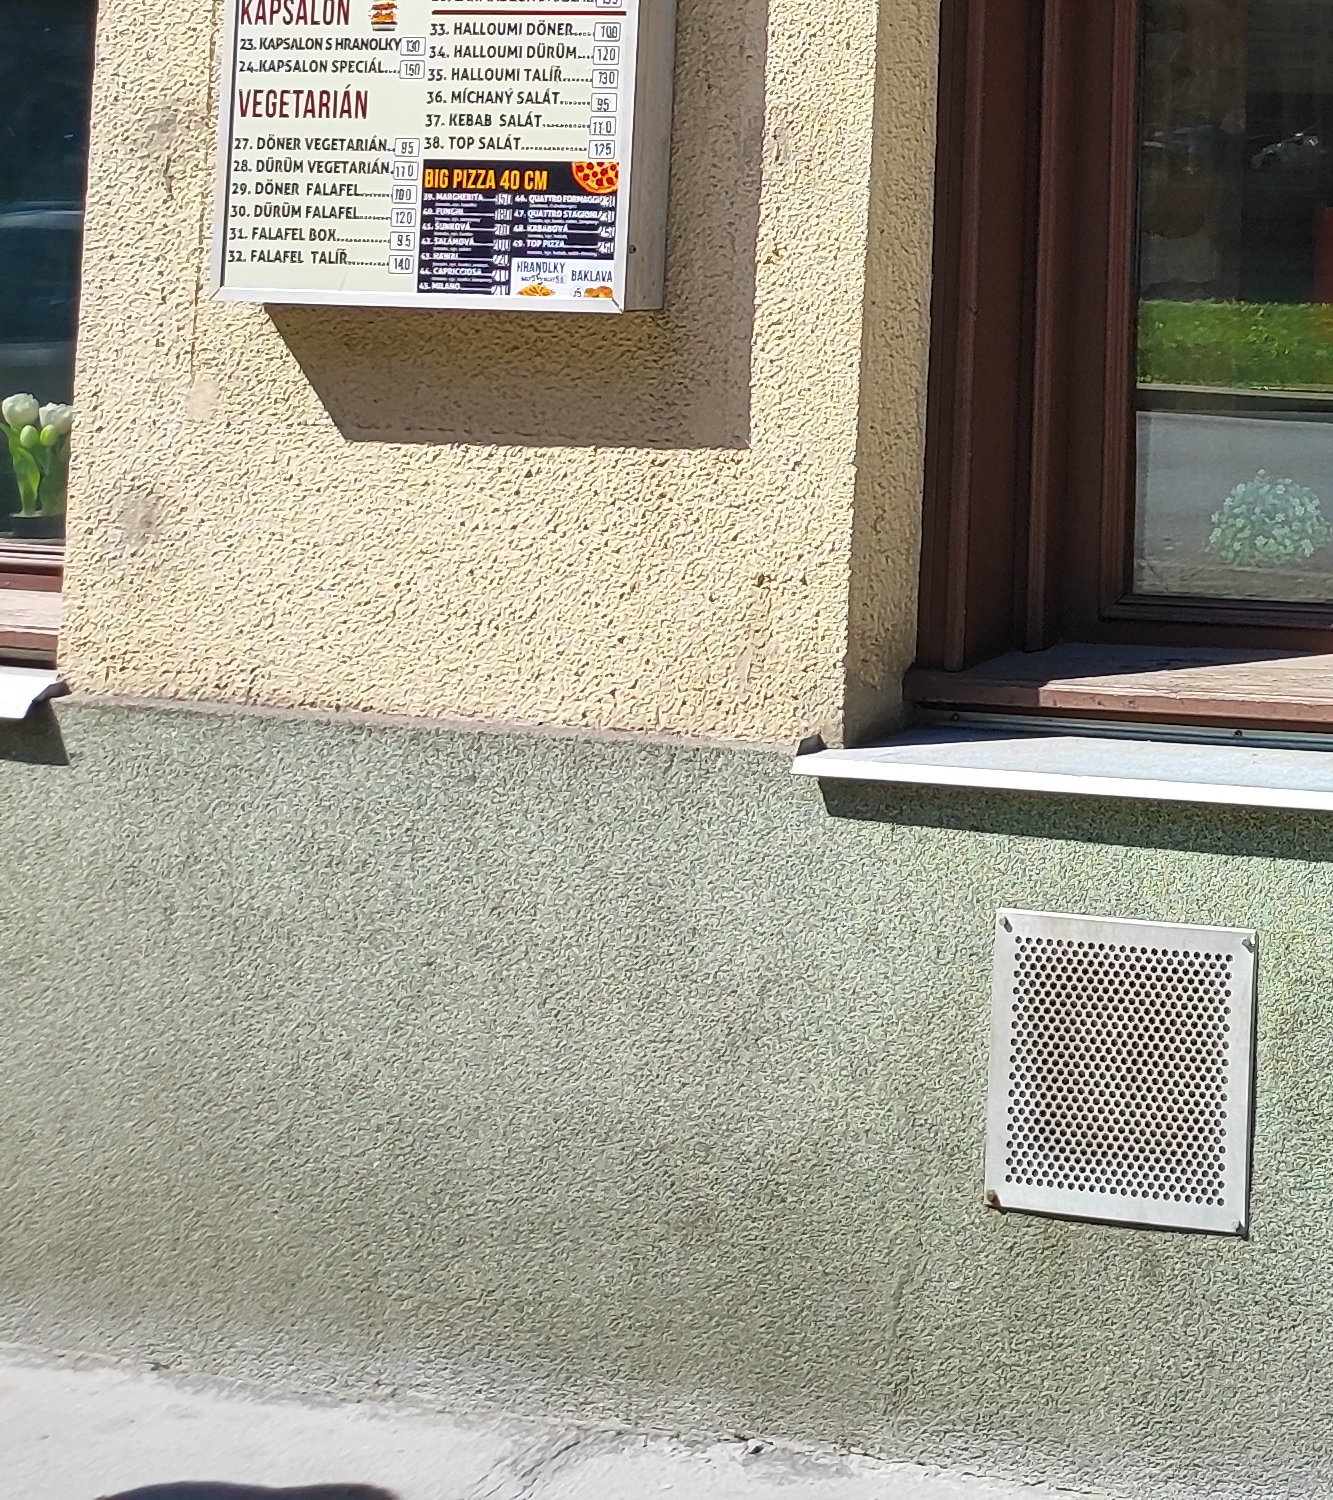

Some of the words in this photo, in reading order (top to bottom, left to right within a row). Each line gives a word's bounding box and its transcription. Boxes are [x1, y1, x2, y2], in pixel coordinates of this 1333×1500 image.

[454, 23, 522, 36] HALLOUMI
[526, 20, 573, 35] DÖNER
[260, 37, 322, 50] KAPSALON
[326, 37, 332, 49] S
[335, 37, 400, 50] HRANOLKY
[453, 45, 522, 59] HALLOUMI
[526, 43, 577, 59] DÜRÜM
[259, 59, 328, 73] KAPSALON
[331, 58, 384, 73] SPECIÁL
[451, 68, 519, 82] HALLOUMI
[525, 65, 562, 82] TALÍŘ
[239, 84, 368, 119] VEGETARIÁN
[450, 88, 513, 105] MÍCHANÝ
[517, 88, 560, 105] SALÁT
[449, 114, 492, 127] KEBAB
[500, 112, 542, 127] SALÁT
[257, 134, 301, 151] DÖNER
[305, 135, 387, 151] VEGETARIÁN
[449, 137, 474, 149] TOP
[479, 133, 521, 149] SALÁT
[256, 157, 303, 173] DÜRÜM
[255, 179, 299, 195] DÖNER
[306, 183, 359, 196] FALAFEL
[424, 169, 449, 189] BIG
[453, 170, 495, 190] PIZZA
[500, 170, 519, 190] 40
[524, 171, 547, 190] CM
[254, 202, 301, 218] DÜRÜM
[305, 206, 358, 219] FALAFEL
[252, 228, 305, 241] FALAFEL
[310, 229, 336, 240] BOX
[251, 251, 304, 263] FALAFEL
[311, 248, 348, 264] TALÍŘ
[571, 270, 612, 282] BAKLAVA
